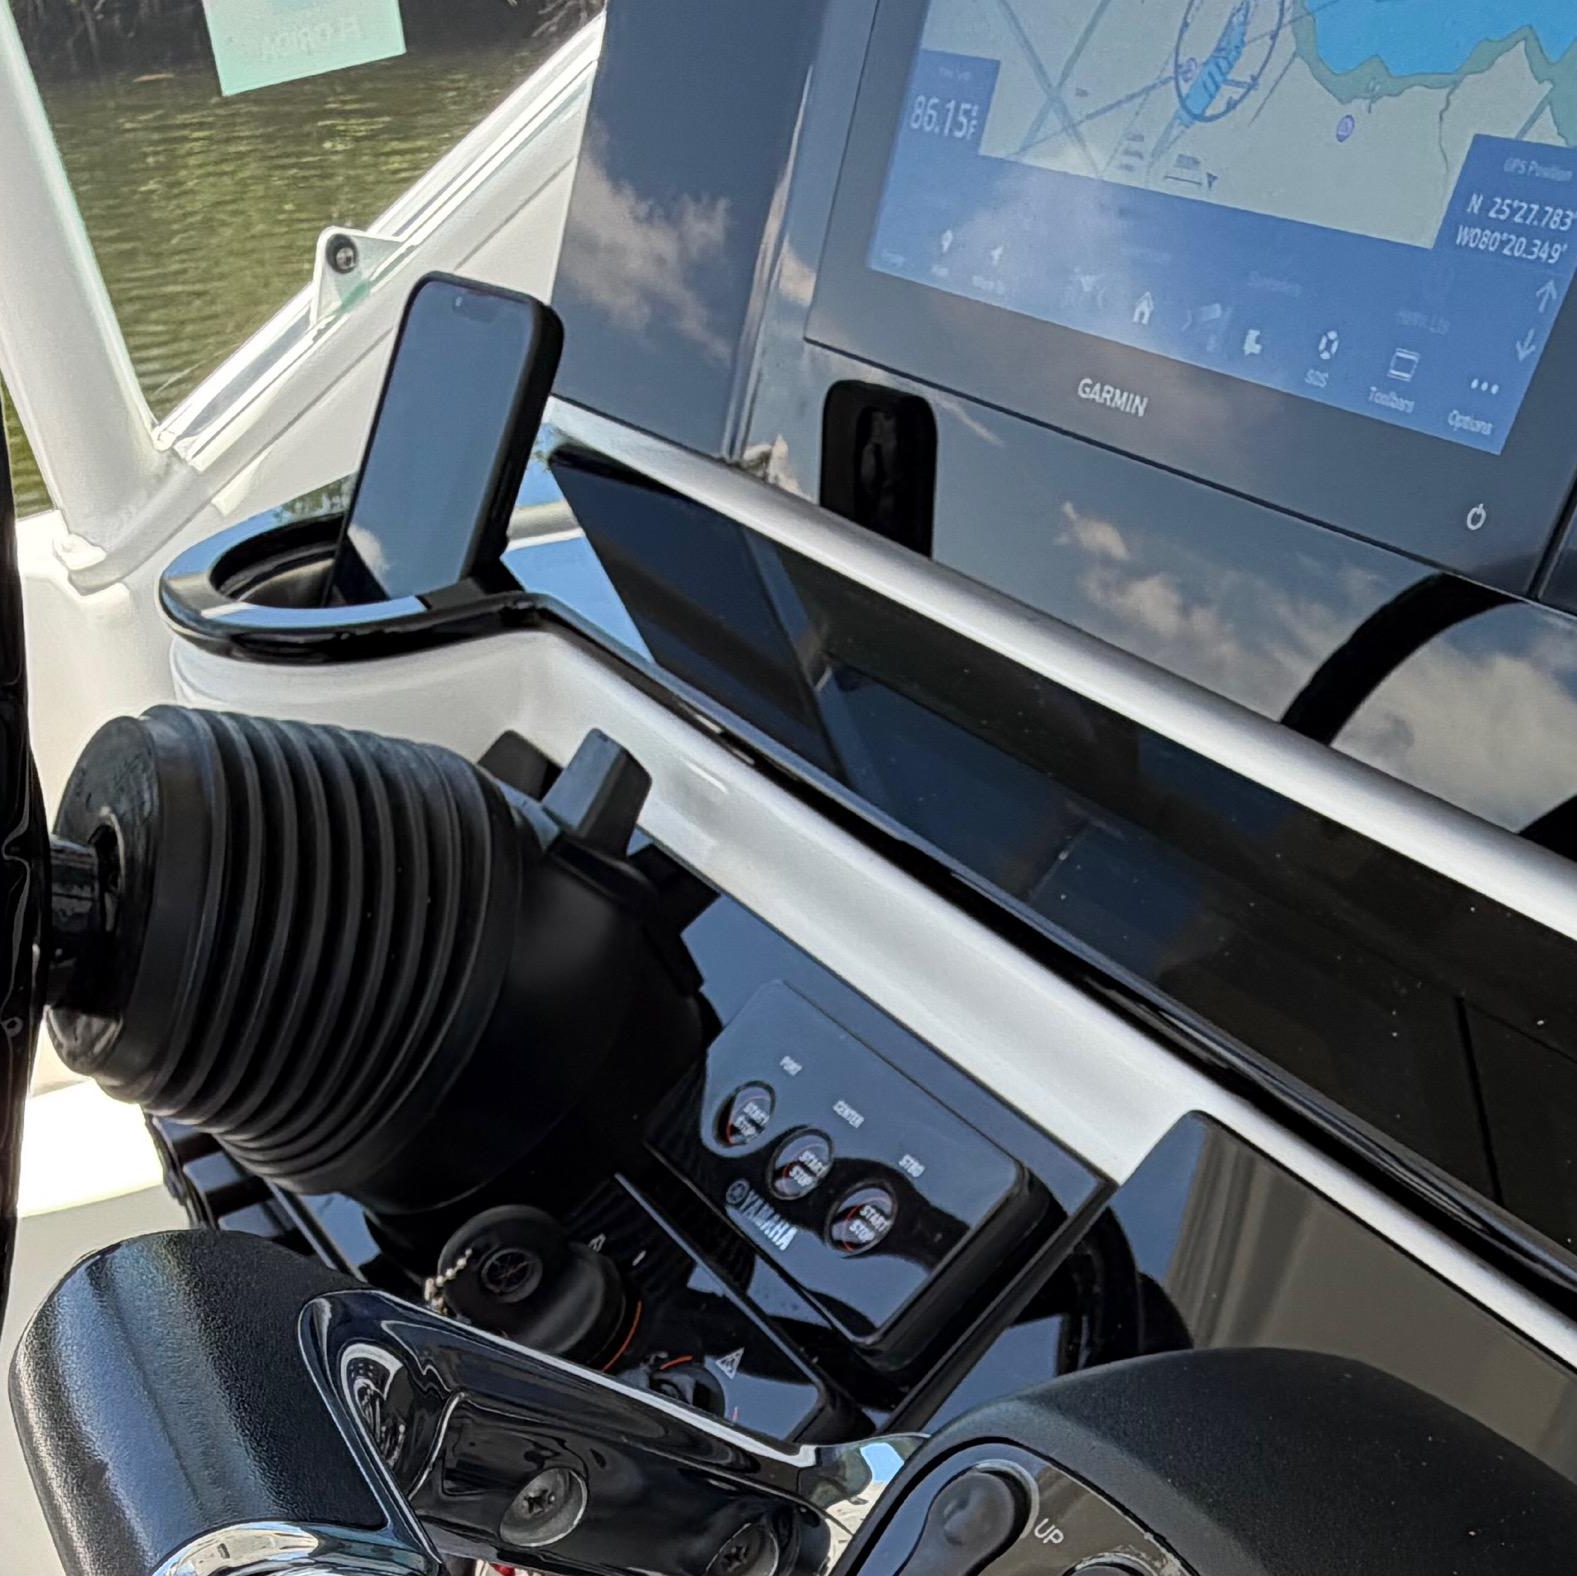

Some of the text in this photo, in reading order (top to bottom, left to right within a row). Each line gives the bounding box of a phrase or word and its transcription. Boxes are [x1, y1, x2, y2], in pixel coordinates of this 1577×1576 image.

[1467, 193, 1483, 214] N
[1077, 377, 1149, 417] GARMIN
[832, 1100, 865, 1129] CENTER
[789, 1164, 815, 1187] STOP
[798, 1150, 828, 1177] START
[738, 1189, 799, 1251] YAMAHA
[849, 1218, 875, 1242] STOP
[859, 1204, 889, 1232] START
[1033, 1517, 1066, 1550] UP
